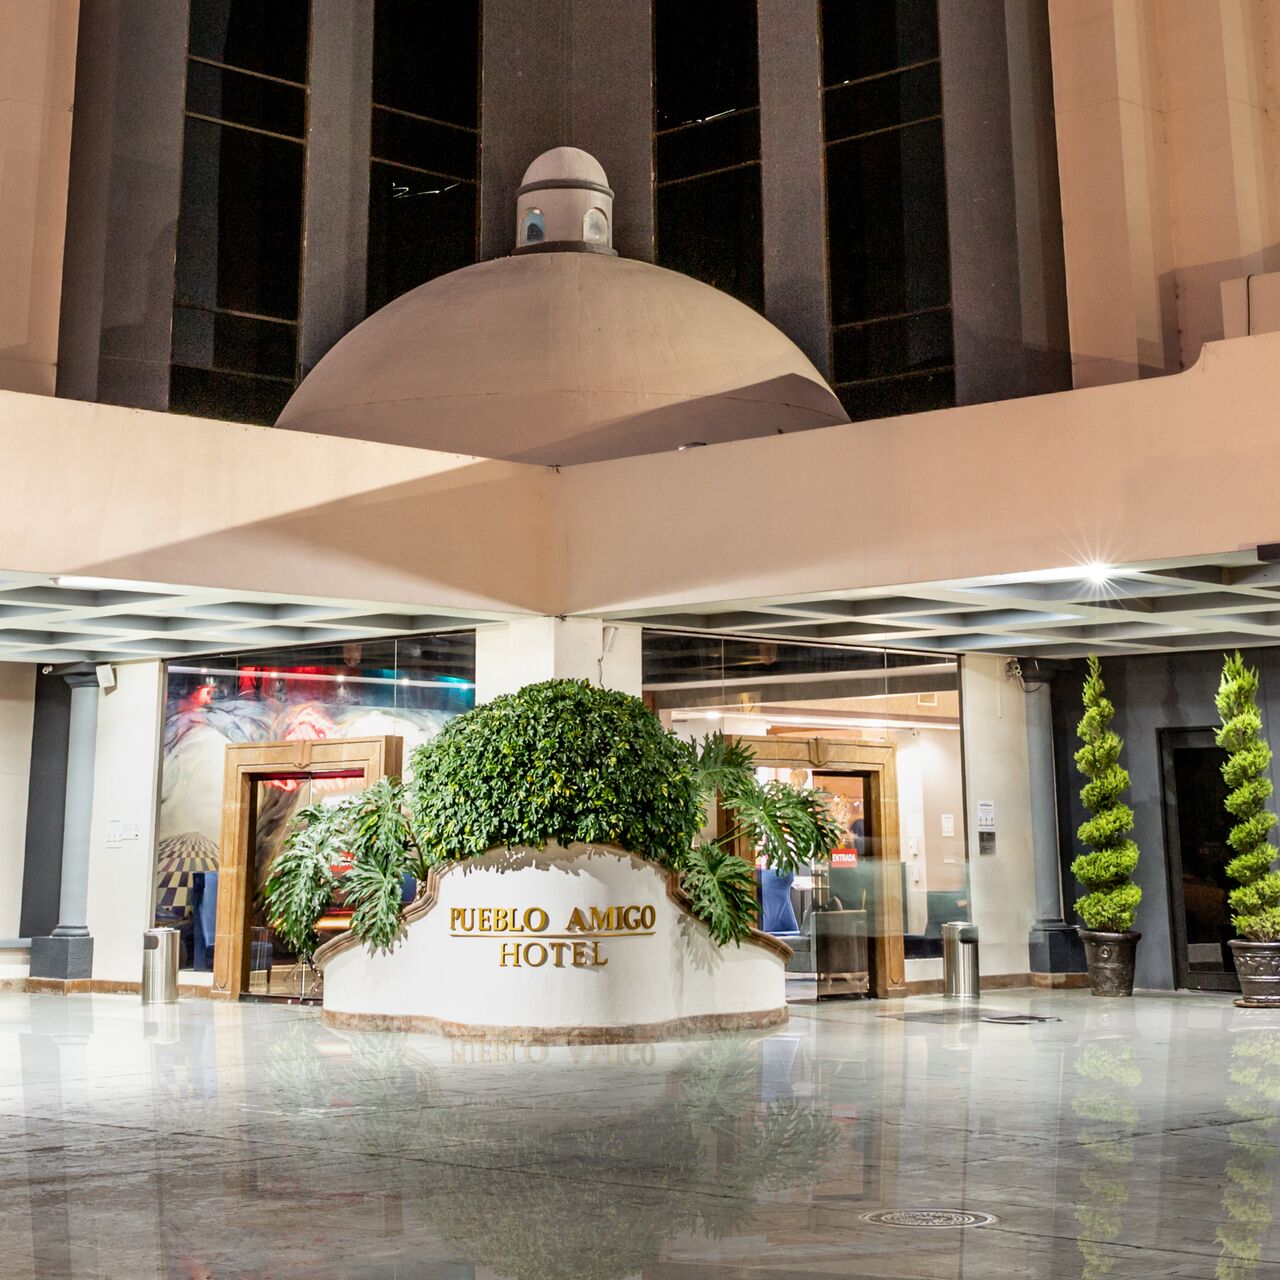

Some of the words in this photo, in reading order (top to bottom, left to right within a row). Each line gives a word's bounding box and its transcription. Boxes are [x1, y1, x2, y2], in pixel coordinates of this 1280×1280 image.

[832, 853, 856, 862] ENTRADA
[450, 907, 548, 932] PUEBLO
[566, 905, 656, 931] AMIGO
[500, 942, 608, 968] HOTEL
